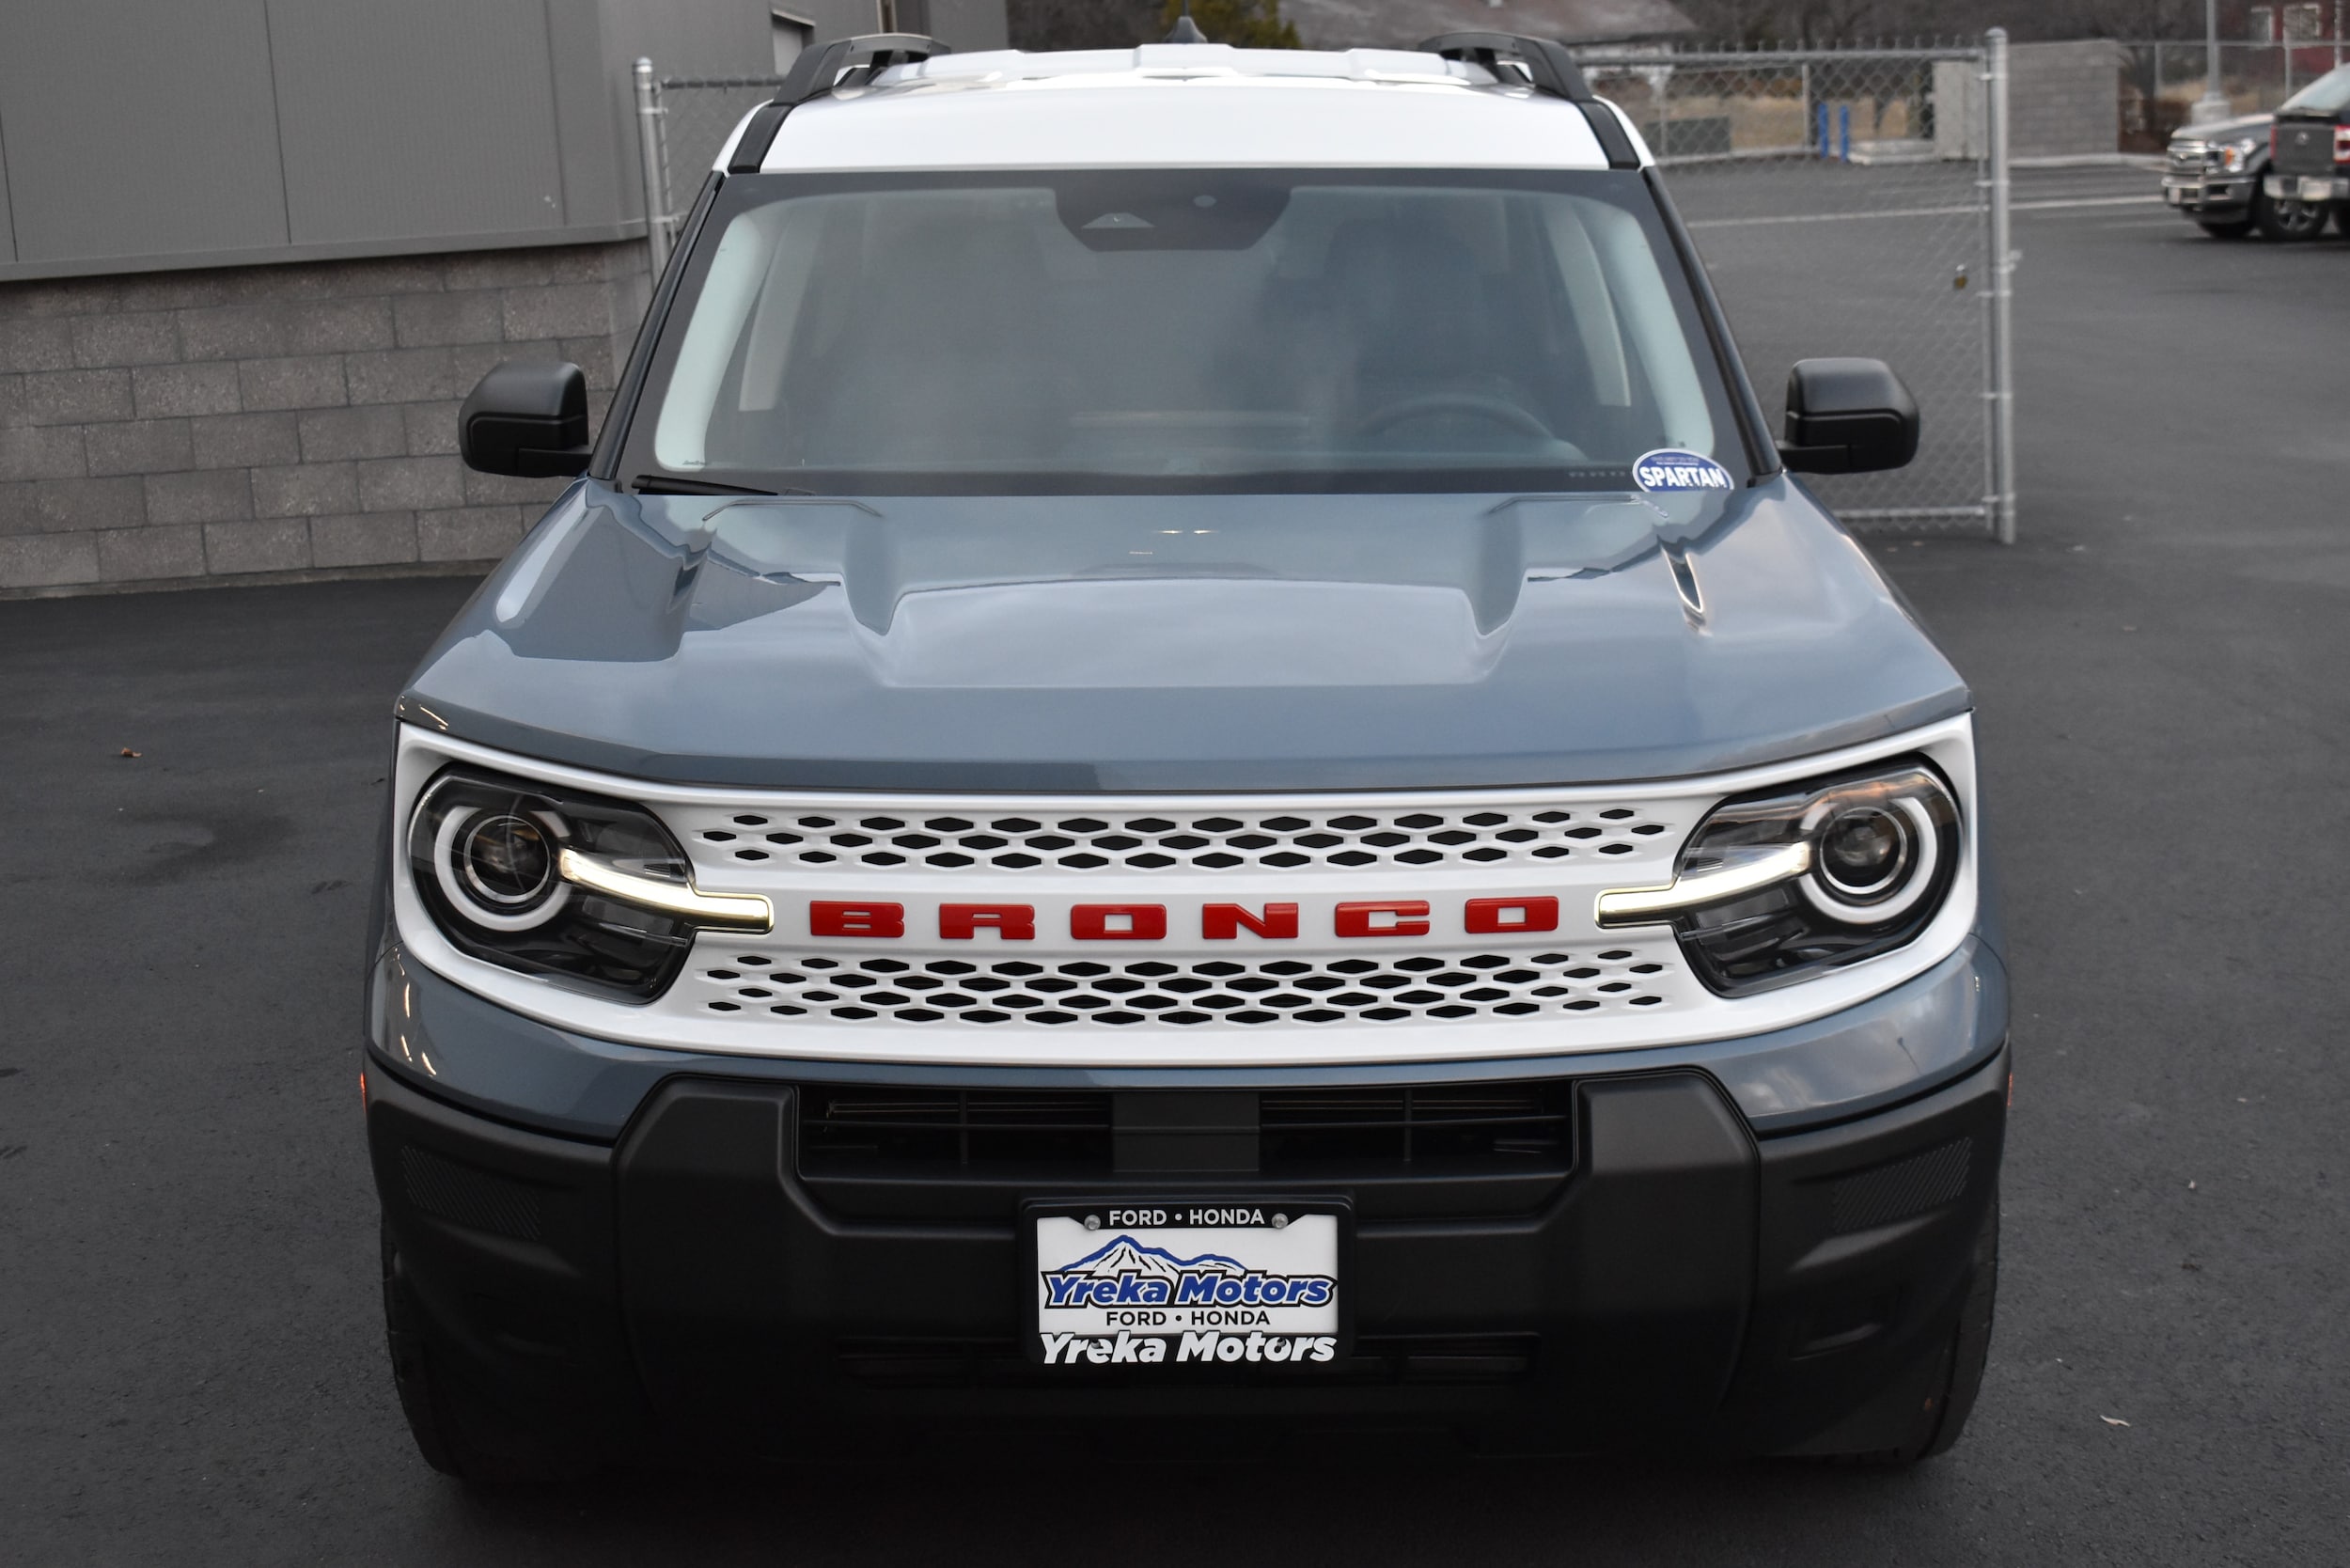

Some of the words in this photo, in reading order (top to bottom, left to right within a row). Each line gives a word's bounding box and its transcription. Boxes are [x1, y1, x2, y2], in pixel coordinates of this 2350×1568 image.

[1639, 466, 1728, 488] SPARTAN
[809, 895, 1559, 939] BRONCO
[1109, 1210, 1167, 1225] FORD
[1189, 1209, 1265, 1225] HONDA
[1046, 1273, 1168, 1304] Yreka
[1178, 1274, 1329, 1304] Motors
[1106, 1311, 1167, 1325] FORD
[1191, 1310, 1271, 1325] HONDA
[1041, 1331, 1167, 1364] Yreka
[1176, 1331, 1338, 1362] Motors
